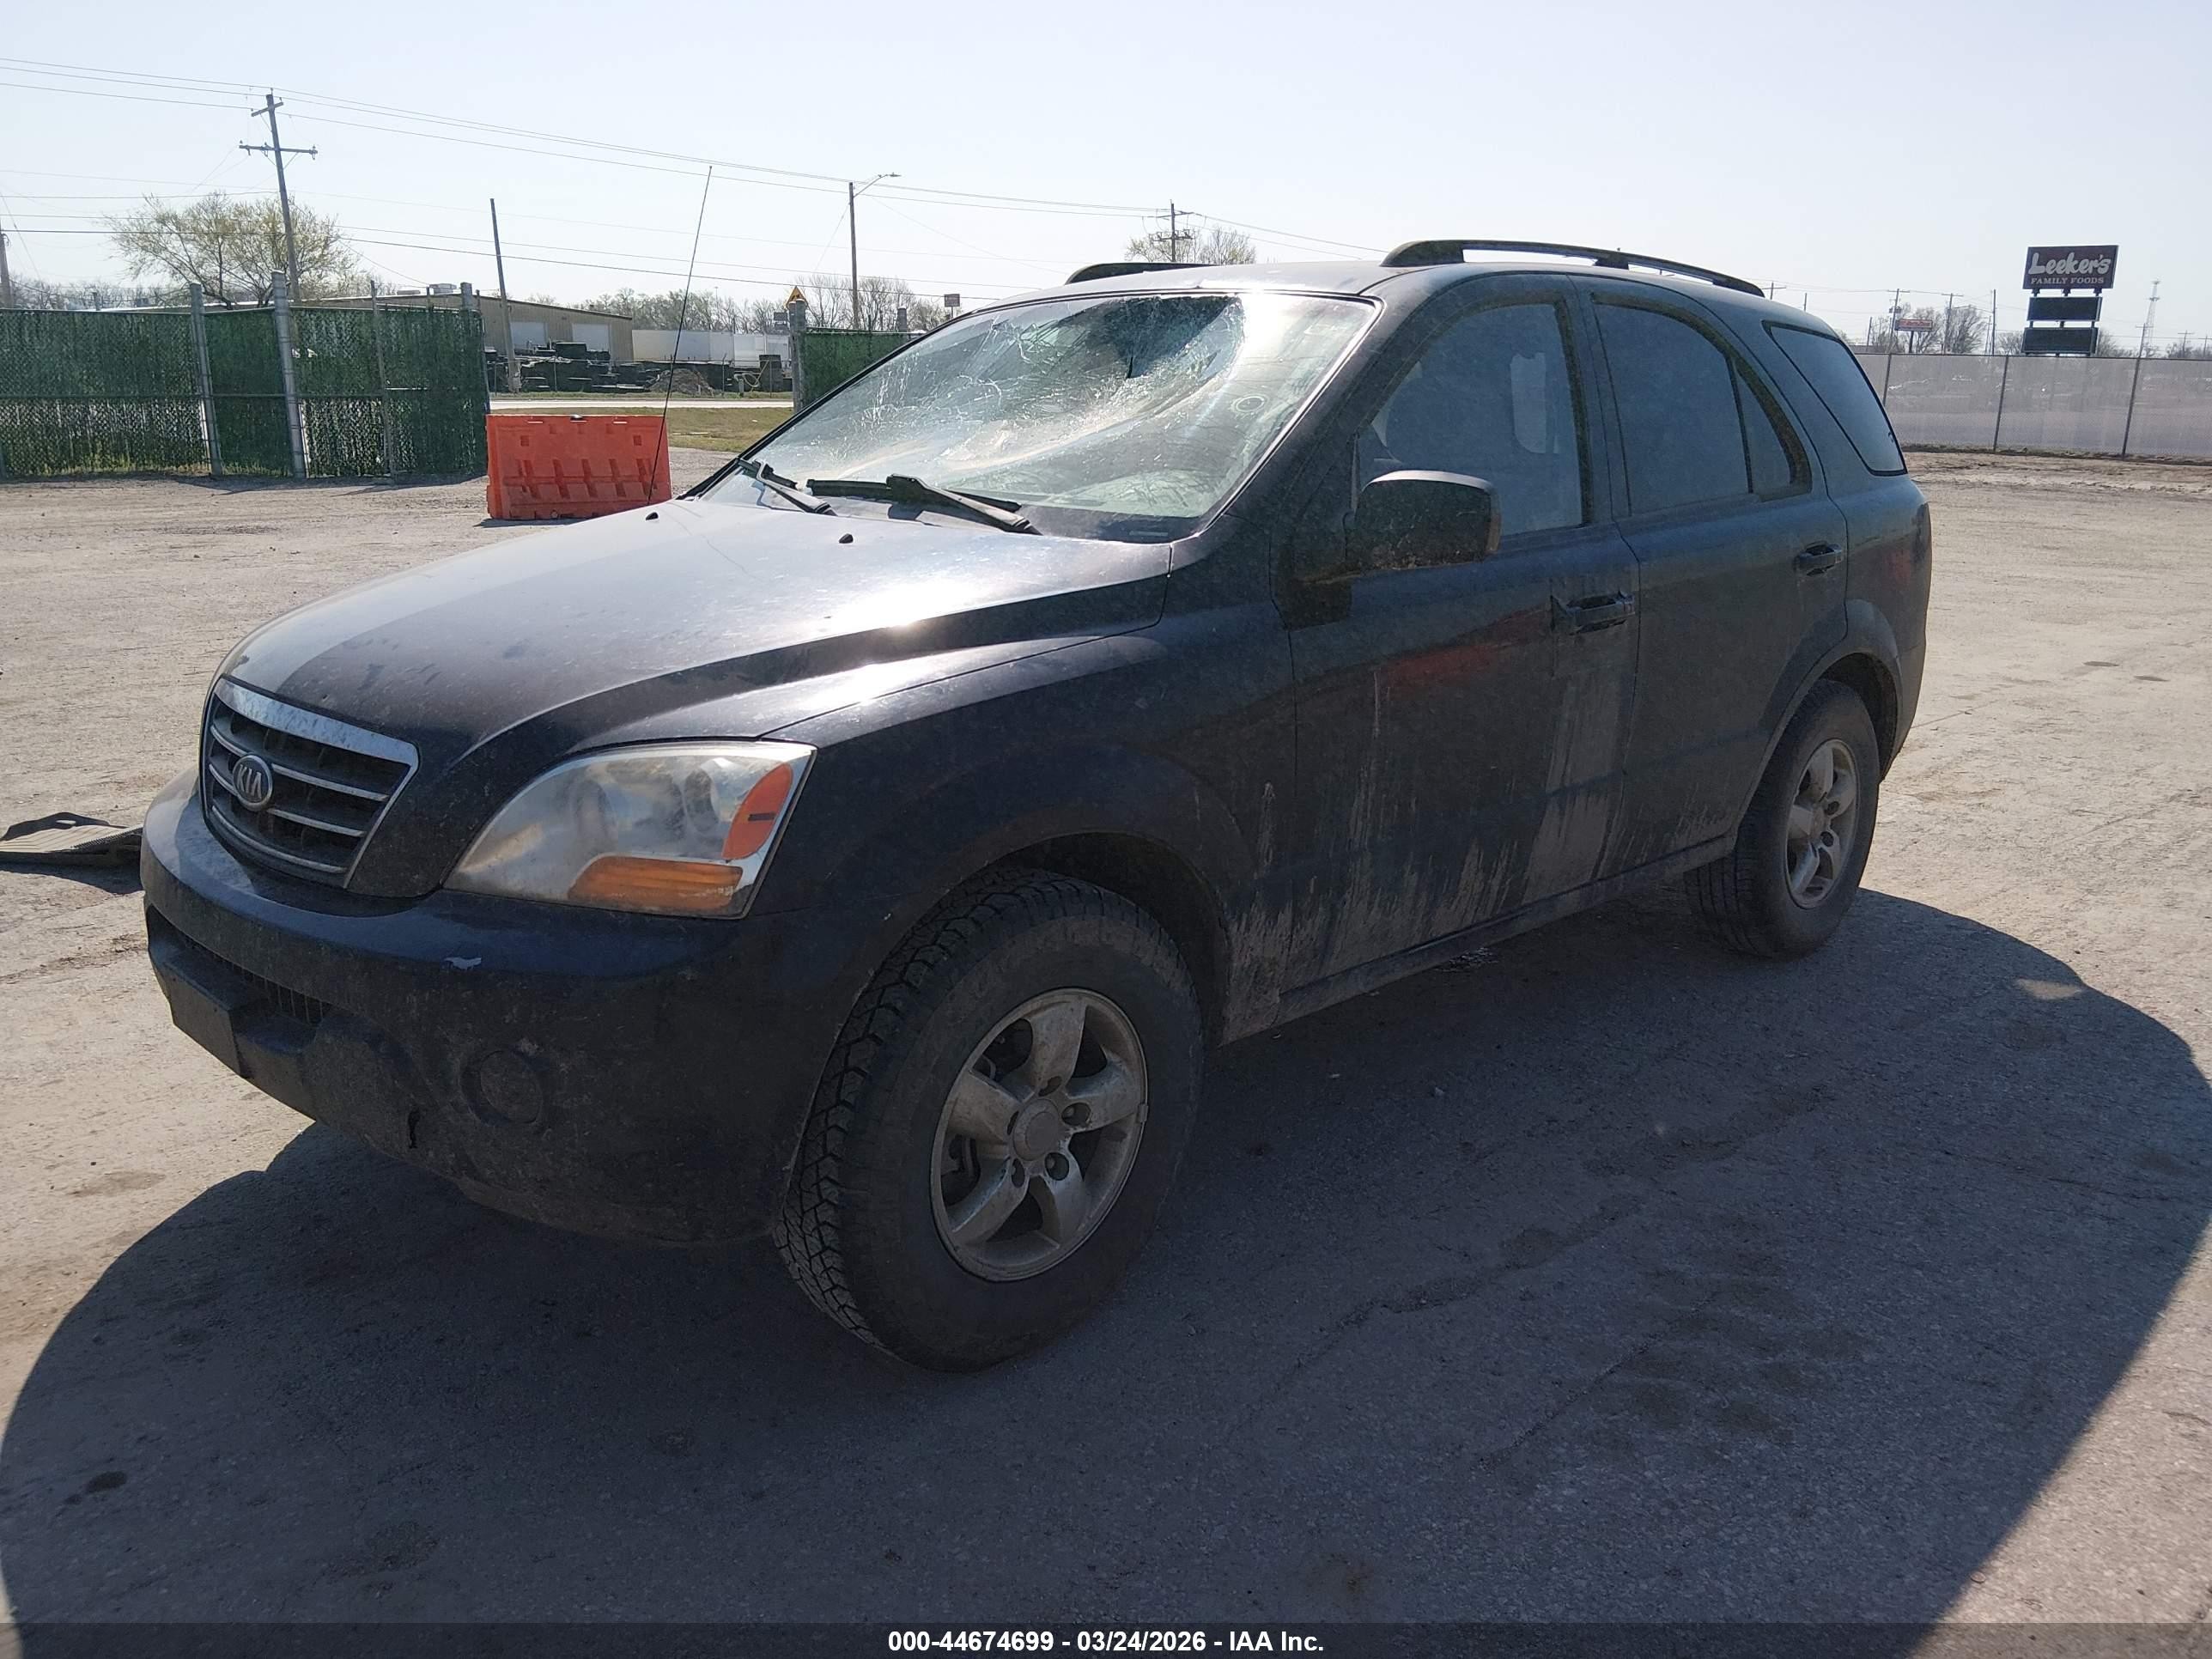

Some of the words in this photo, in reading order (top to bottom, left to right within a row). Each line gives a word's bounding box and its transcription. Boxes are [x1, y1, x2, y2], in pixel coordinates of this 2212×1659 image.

[2027, 252, 2112, 275] Leeker's
[2030, 276, 2068, 285] FAMILY
[236, 763, 263, 800] KIA
